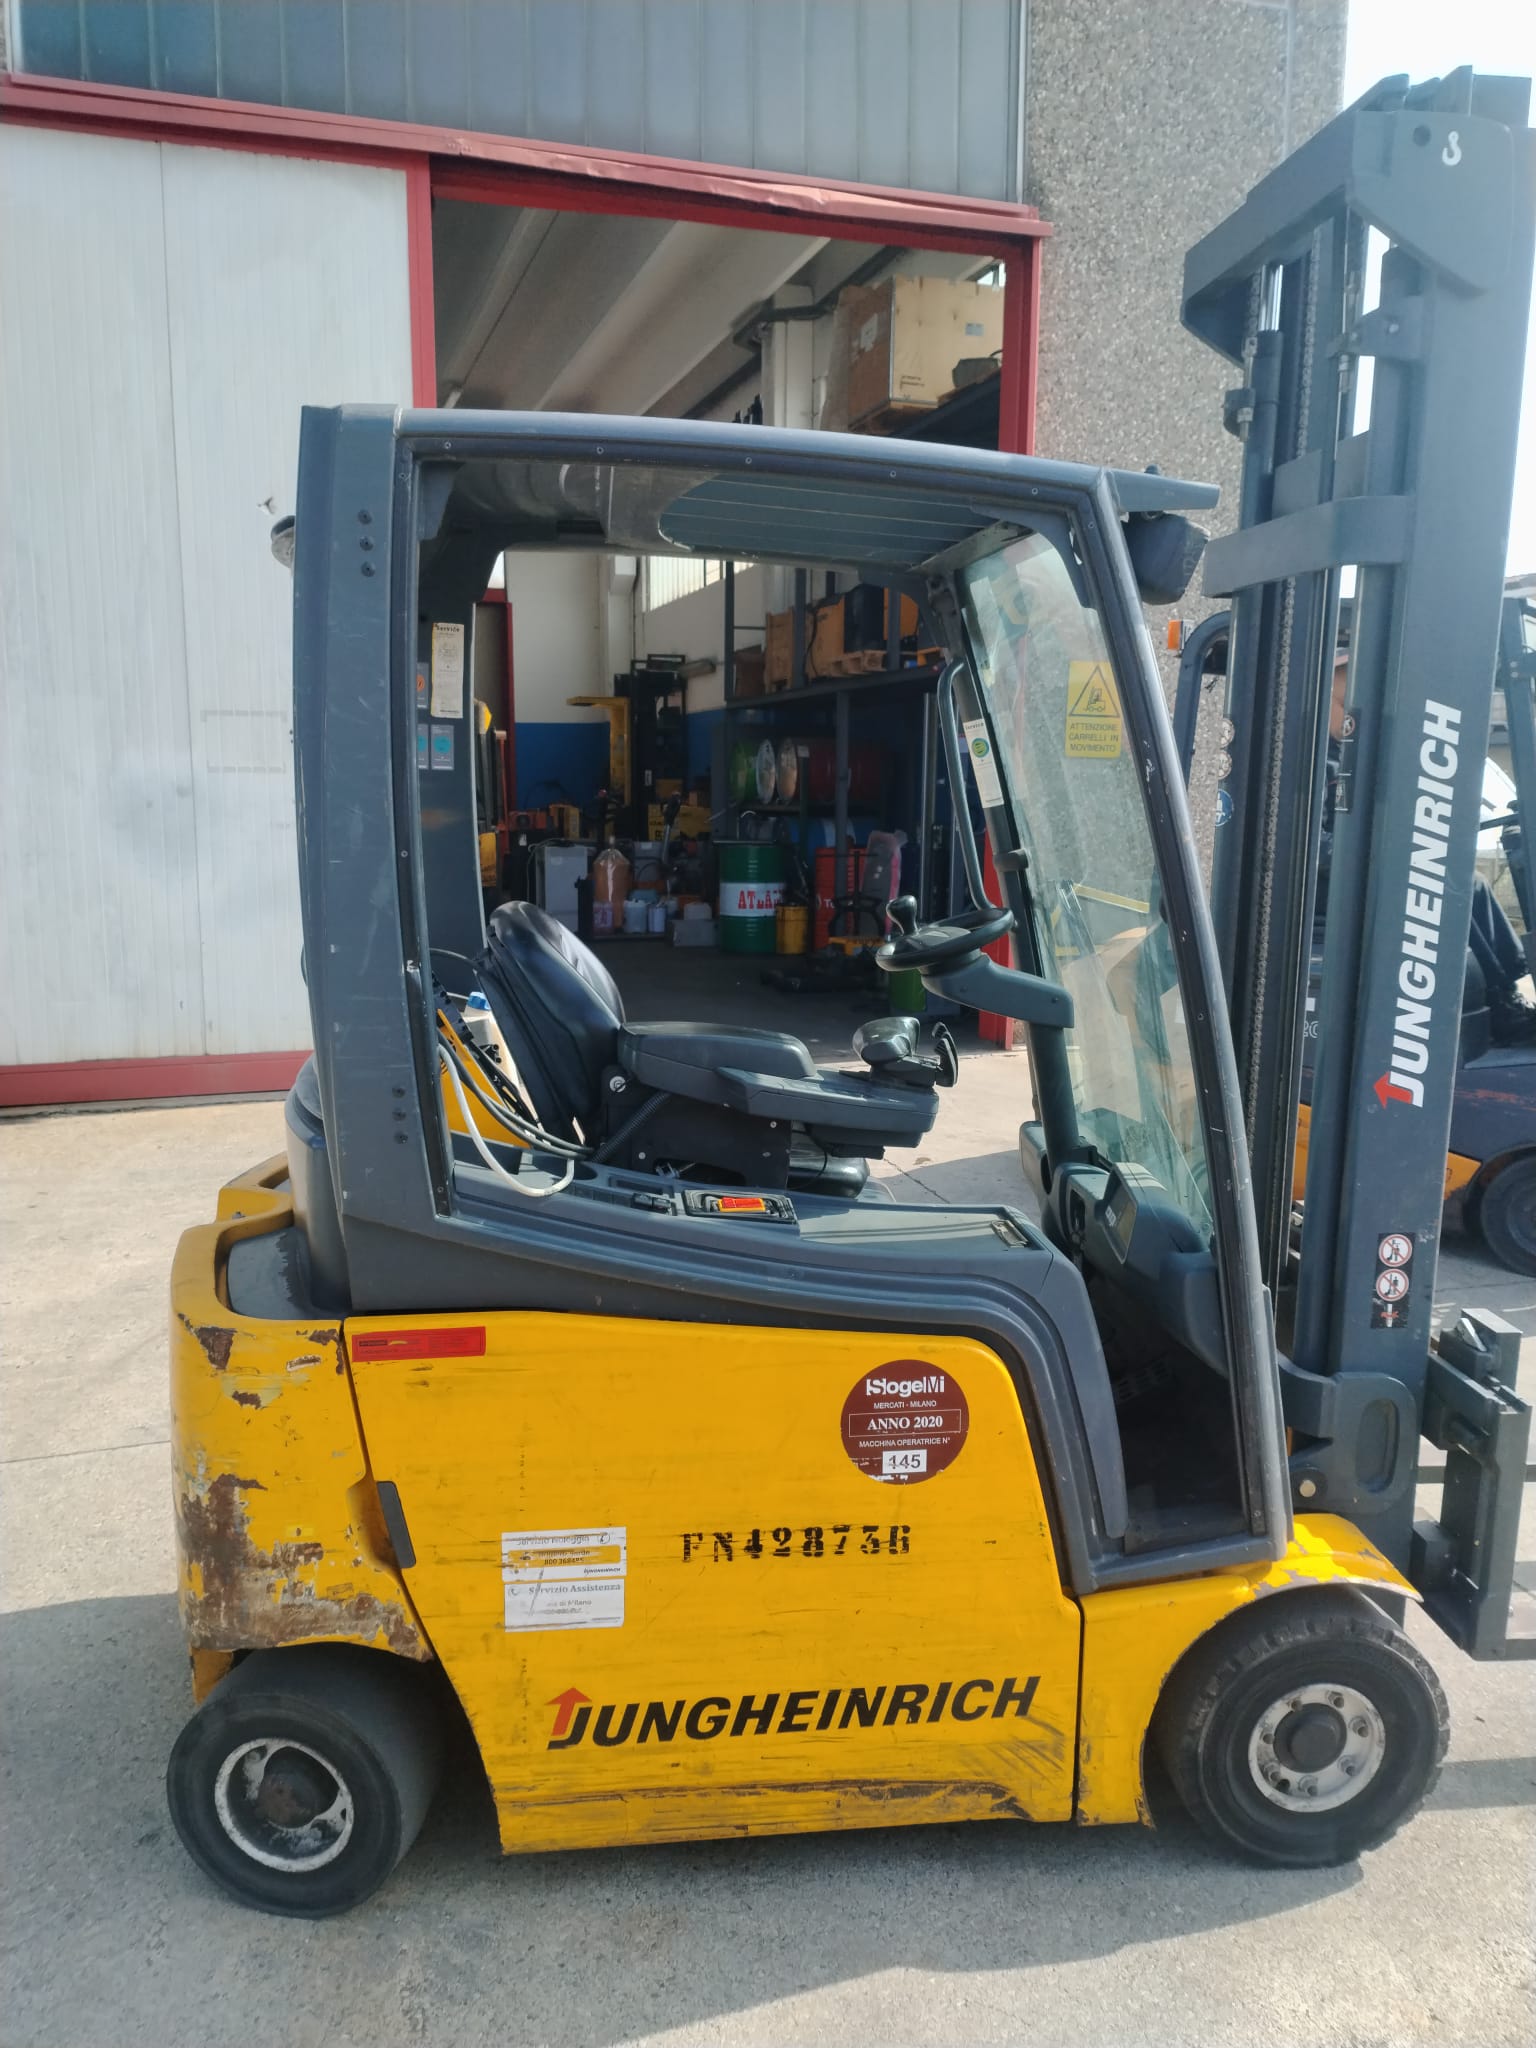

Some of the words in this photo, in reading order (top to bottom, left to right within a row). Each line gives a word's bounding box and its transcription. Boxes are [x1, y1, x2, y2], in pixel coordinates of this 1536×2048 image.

[1385, 699, 1462, 1108] JUNGHEINRICH
[873, 1401, 905, 1409] MERCATI
[910, 1400, 937, 1408] MILANO
[867, 1417, 911, 1430] ANNO
[913, 1416, 943, 1428] 2020
[859, 1439, 896, 1447] MACCHINA
[897, 1437, 941, 1446] OPERATRICE
[889, 1454, 920, 1469] 145
[570, 1584, 621, 1593] Assistenza
[546, 1675, 1041, 1750] JUNGHEINRICH
